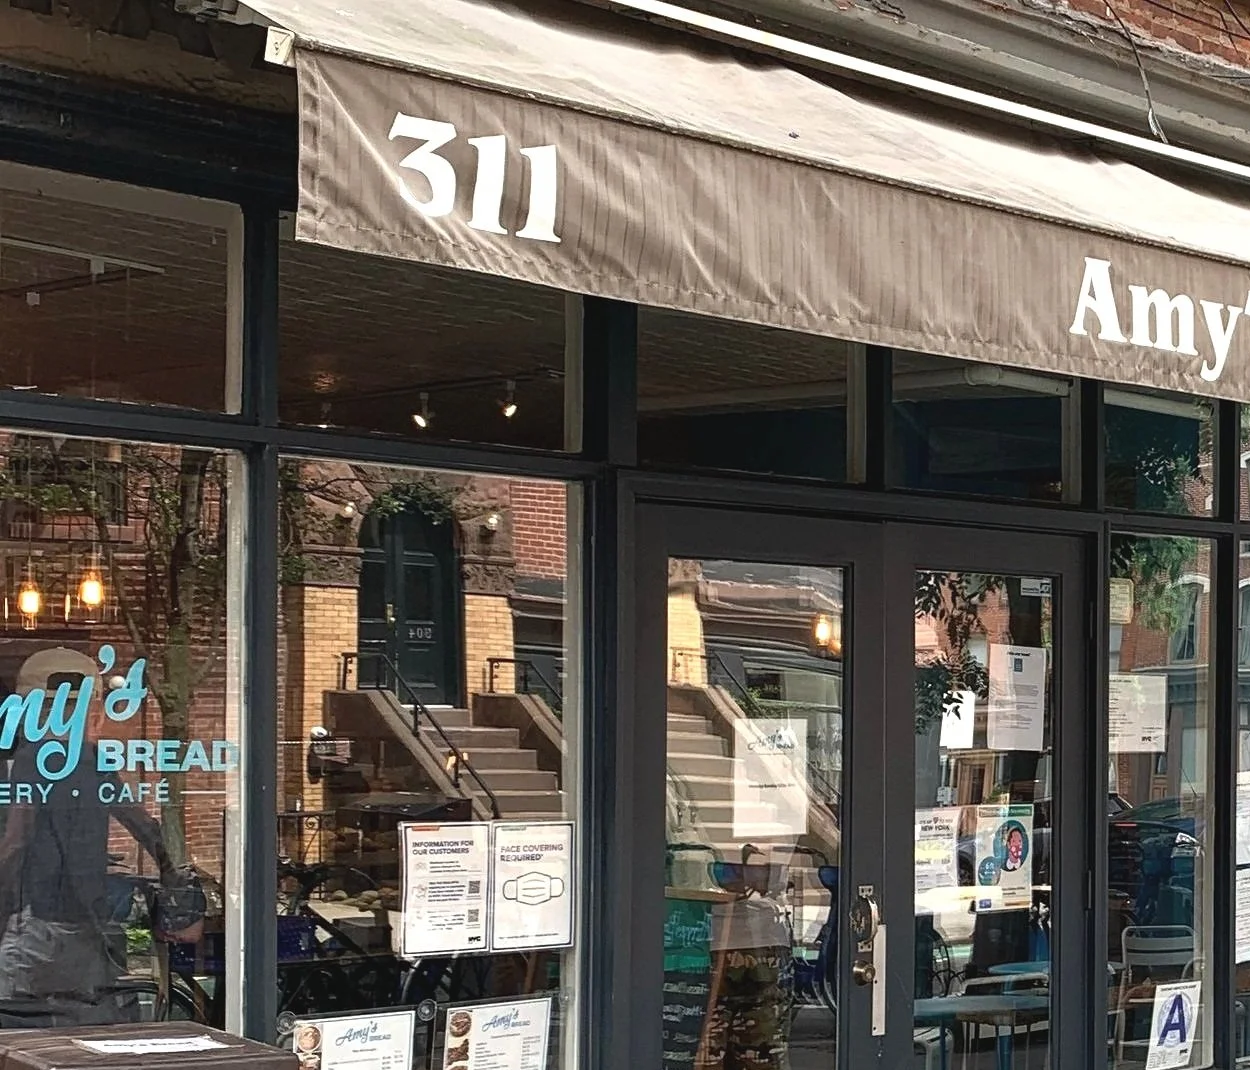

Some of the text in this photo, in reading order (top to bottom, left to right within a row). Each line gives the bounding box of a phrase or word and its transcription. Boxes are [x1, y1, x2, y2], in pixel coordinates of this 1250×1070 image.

[388, 112, 562, 243] 311
[97, 739, 239, 772] BREAD
[98, 778, 170, 803] CAFÉ
[412, 840, 460, 848] INFORMATION
[428, 847, 470, 855] CUSTOMERS
[500, 843, 564, 853] FACE COVERING
[1156, 994, 1187, 1046] A
